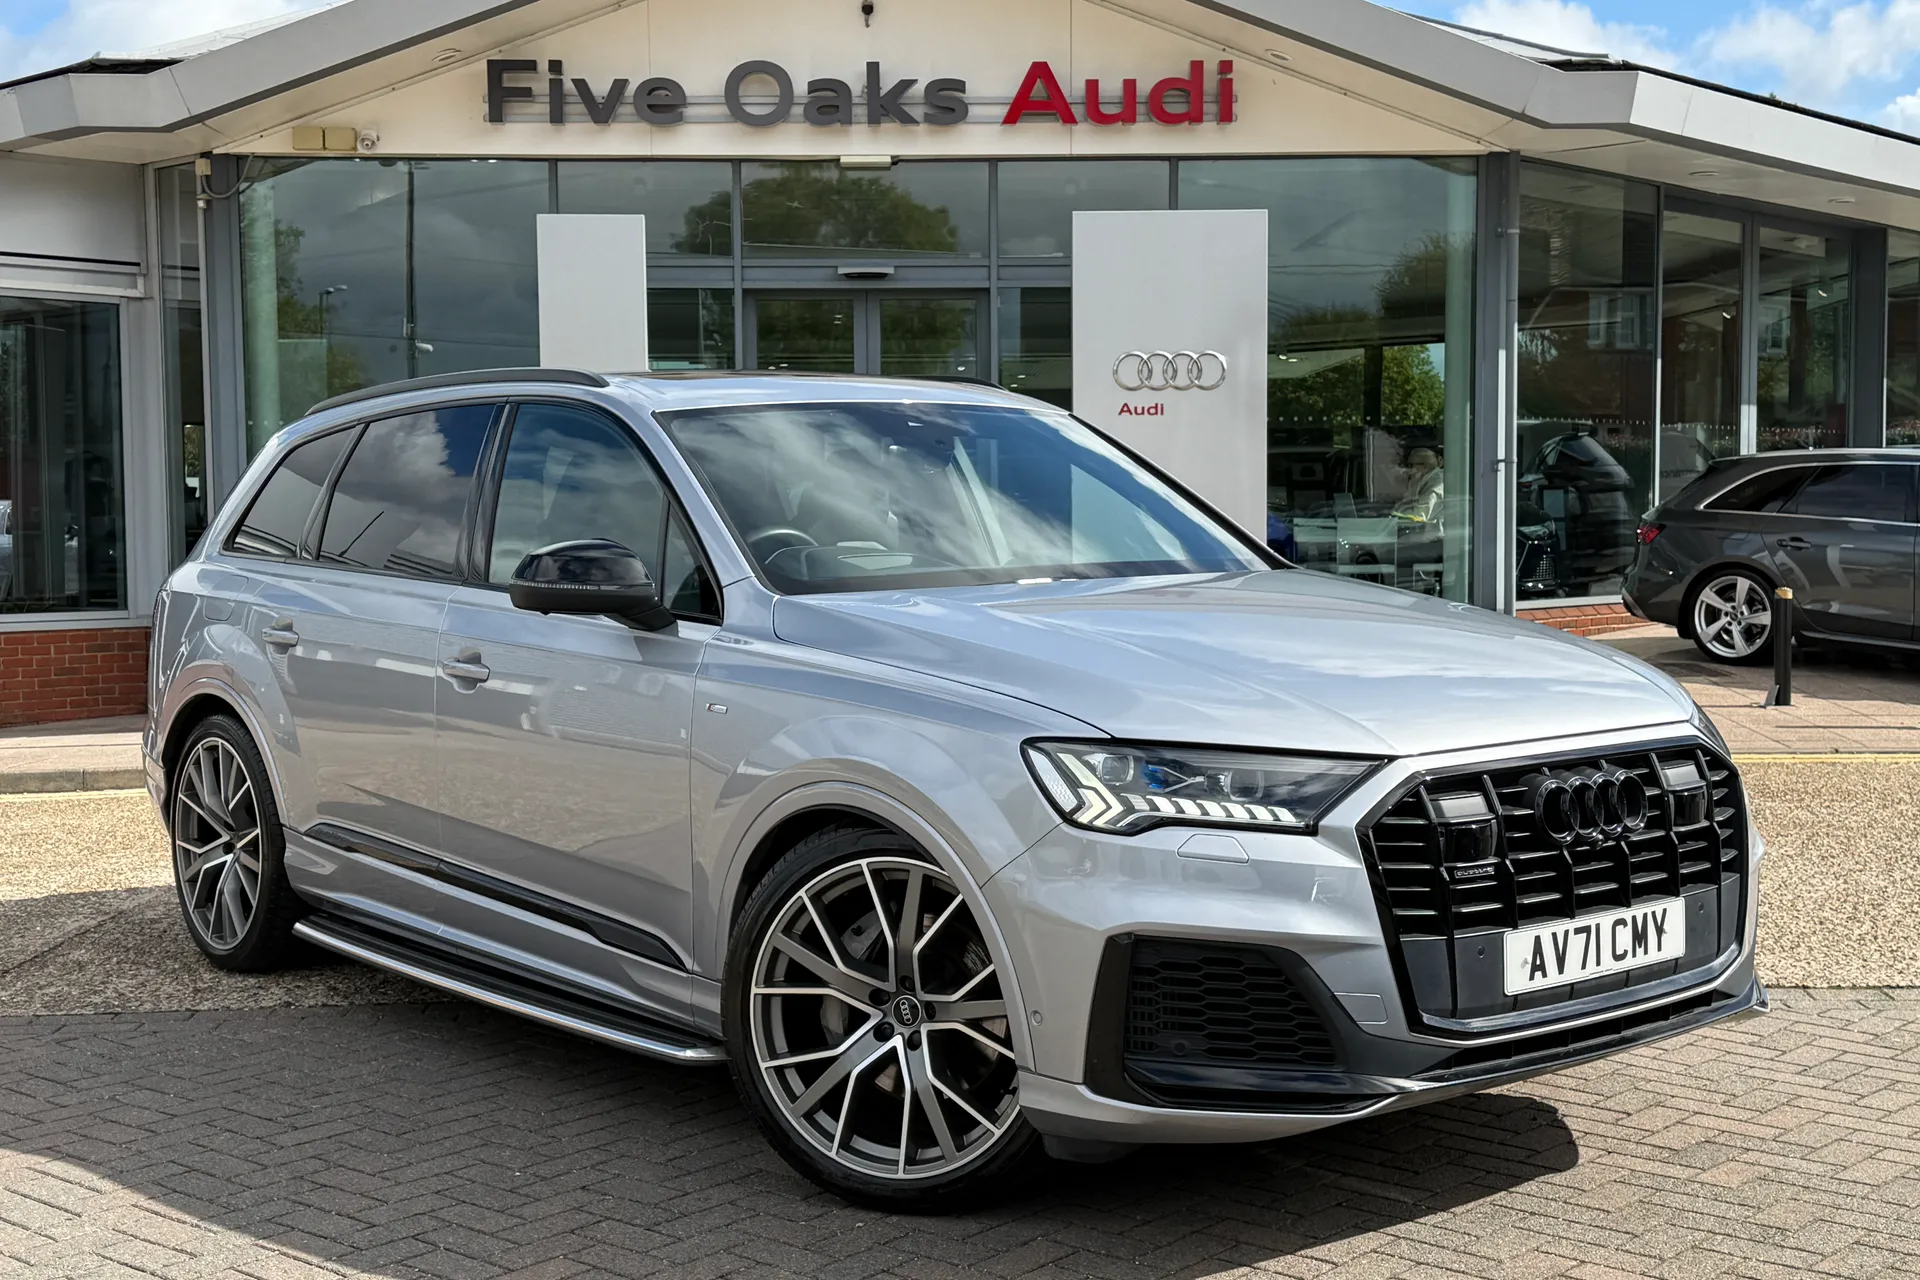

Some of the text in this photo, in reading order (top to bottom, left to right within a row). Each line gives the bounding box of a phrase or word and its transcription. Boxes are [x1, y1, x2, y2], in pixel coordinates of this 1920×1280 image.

[486, 59, 1234, 127] Five Oaks Audi
[1118, 402, 1165, 416] Audi
